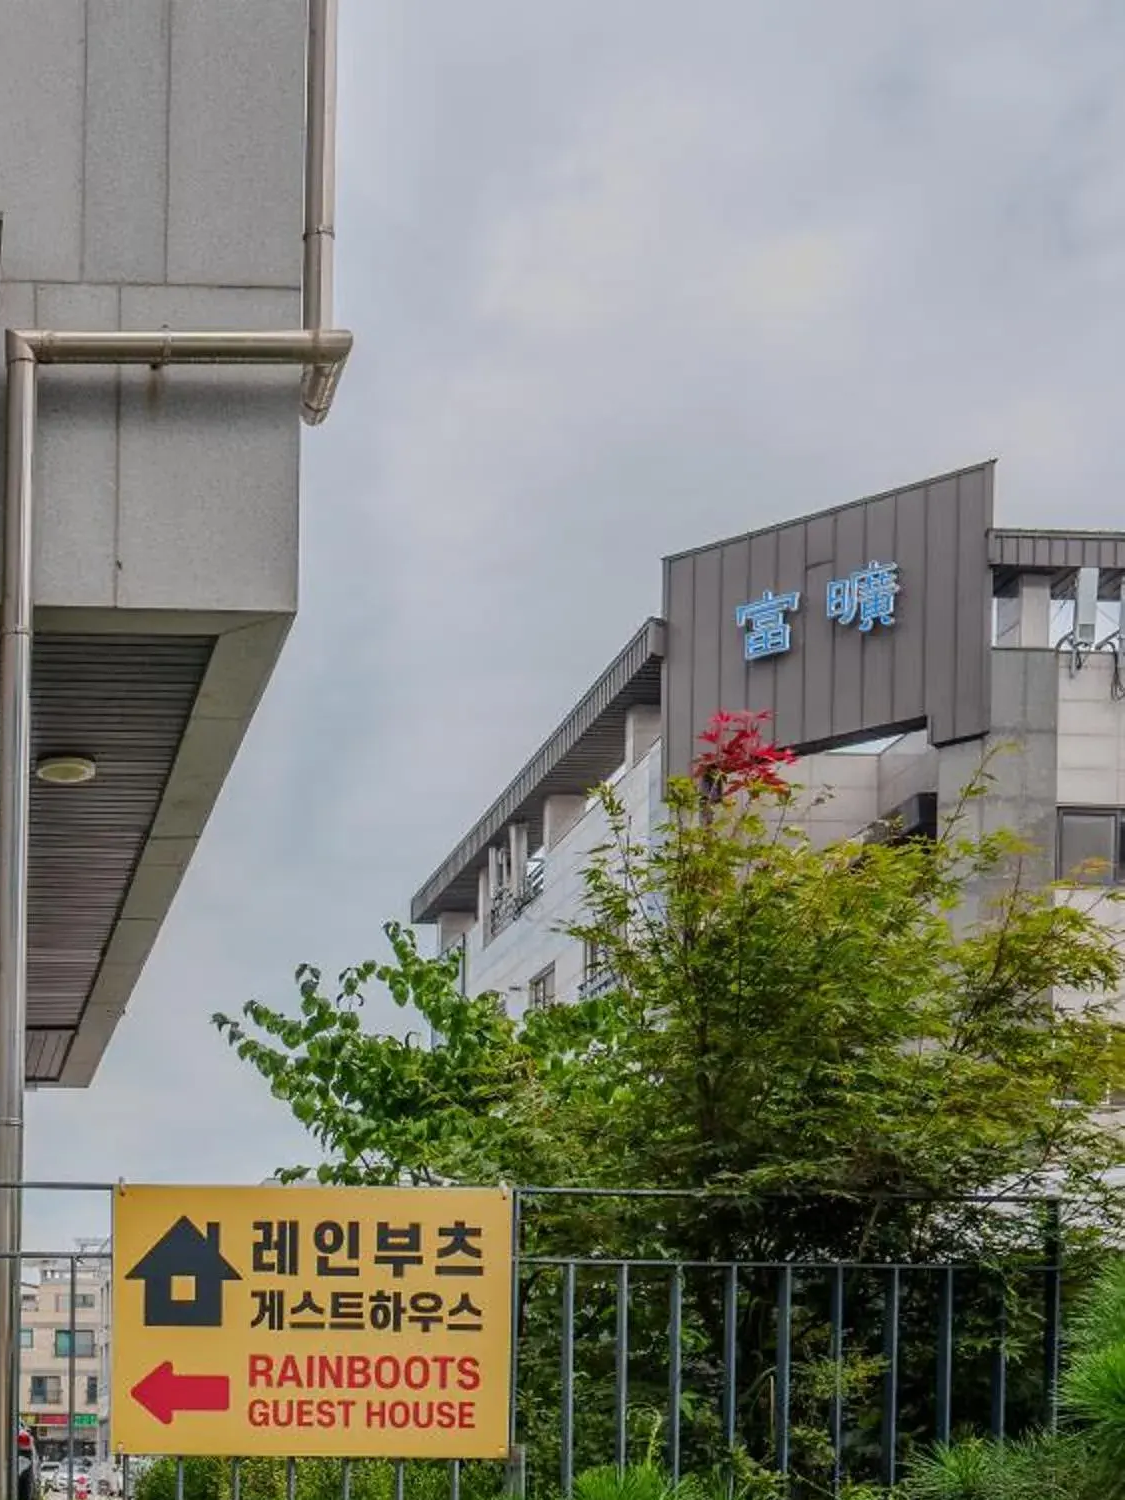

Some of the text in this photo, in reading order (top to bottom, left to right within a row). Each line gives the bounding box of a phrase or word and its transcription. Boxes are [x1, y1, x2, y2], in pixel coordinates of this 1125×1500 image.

[252, 1220, 484, 1278] 레인부츠
[250, 1290, 484, 1332] 게스트하우스
[248, 1354, 480, 1390] RAINBOOTS
[248, 1399, 476, 1429] GUEST HOUSE
